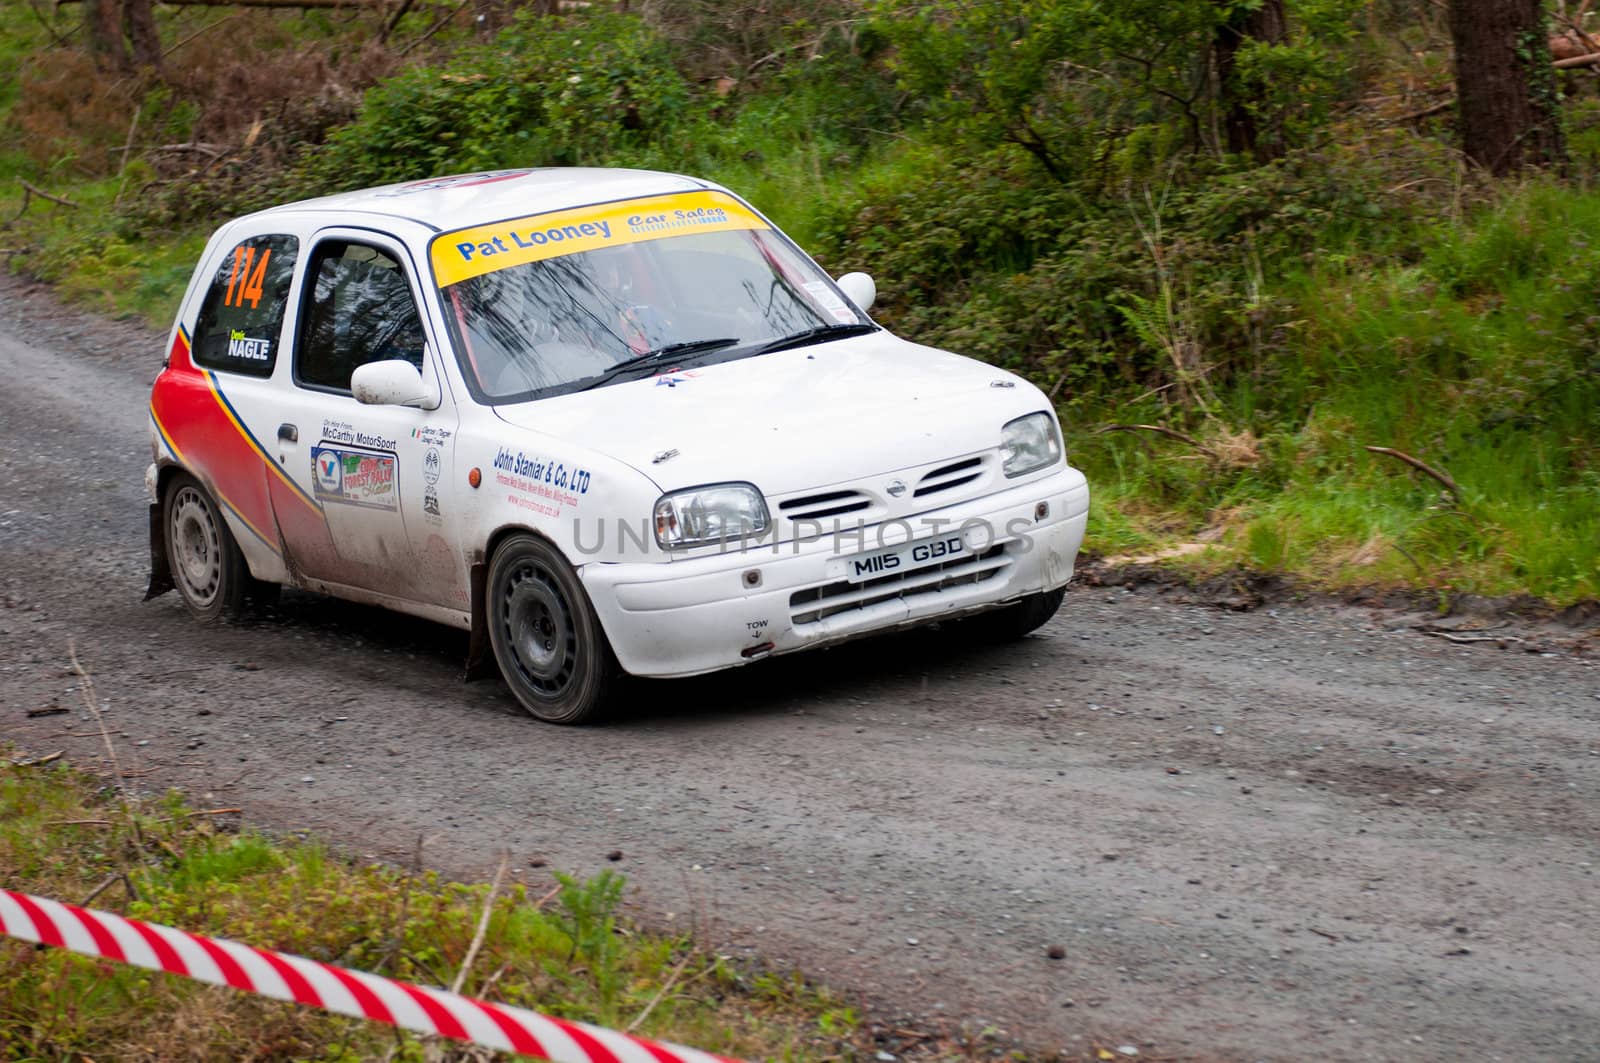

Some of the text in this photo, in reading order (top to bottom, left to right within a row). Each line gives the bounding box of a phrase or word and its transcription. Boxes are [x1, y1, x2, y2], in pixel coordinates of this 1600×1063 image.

[456, 207, 726, 261] Pat Looney Car Sales
[224, 246, 272, 310] 114
[228, 339, 270, 361] NAGLE
[322, 426, 397, 450] McCarthy MotorSport
[494, 446, 514, 472] John
[514, 452, 545, 481] Staniar
[545, 460, 554, 484] &
[569, 467, 591, 495] LTD
[912, 537, 963, 562] GBD
[746, 619, 769, 630] TOW
